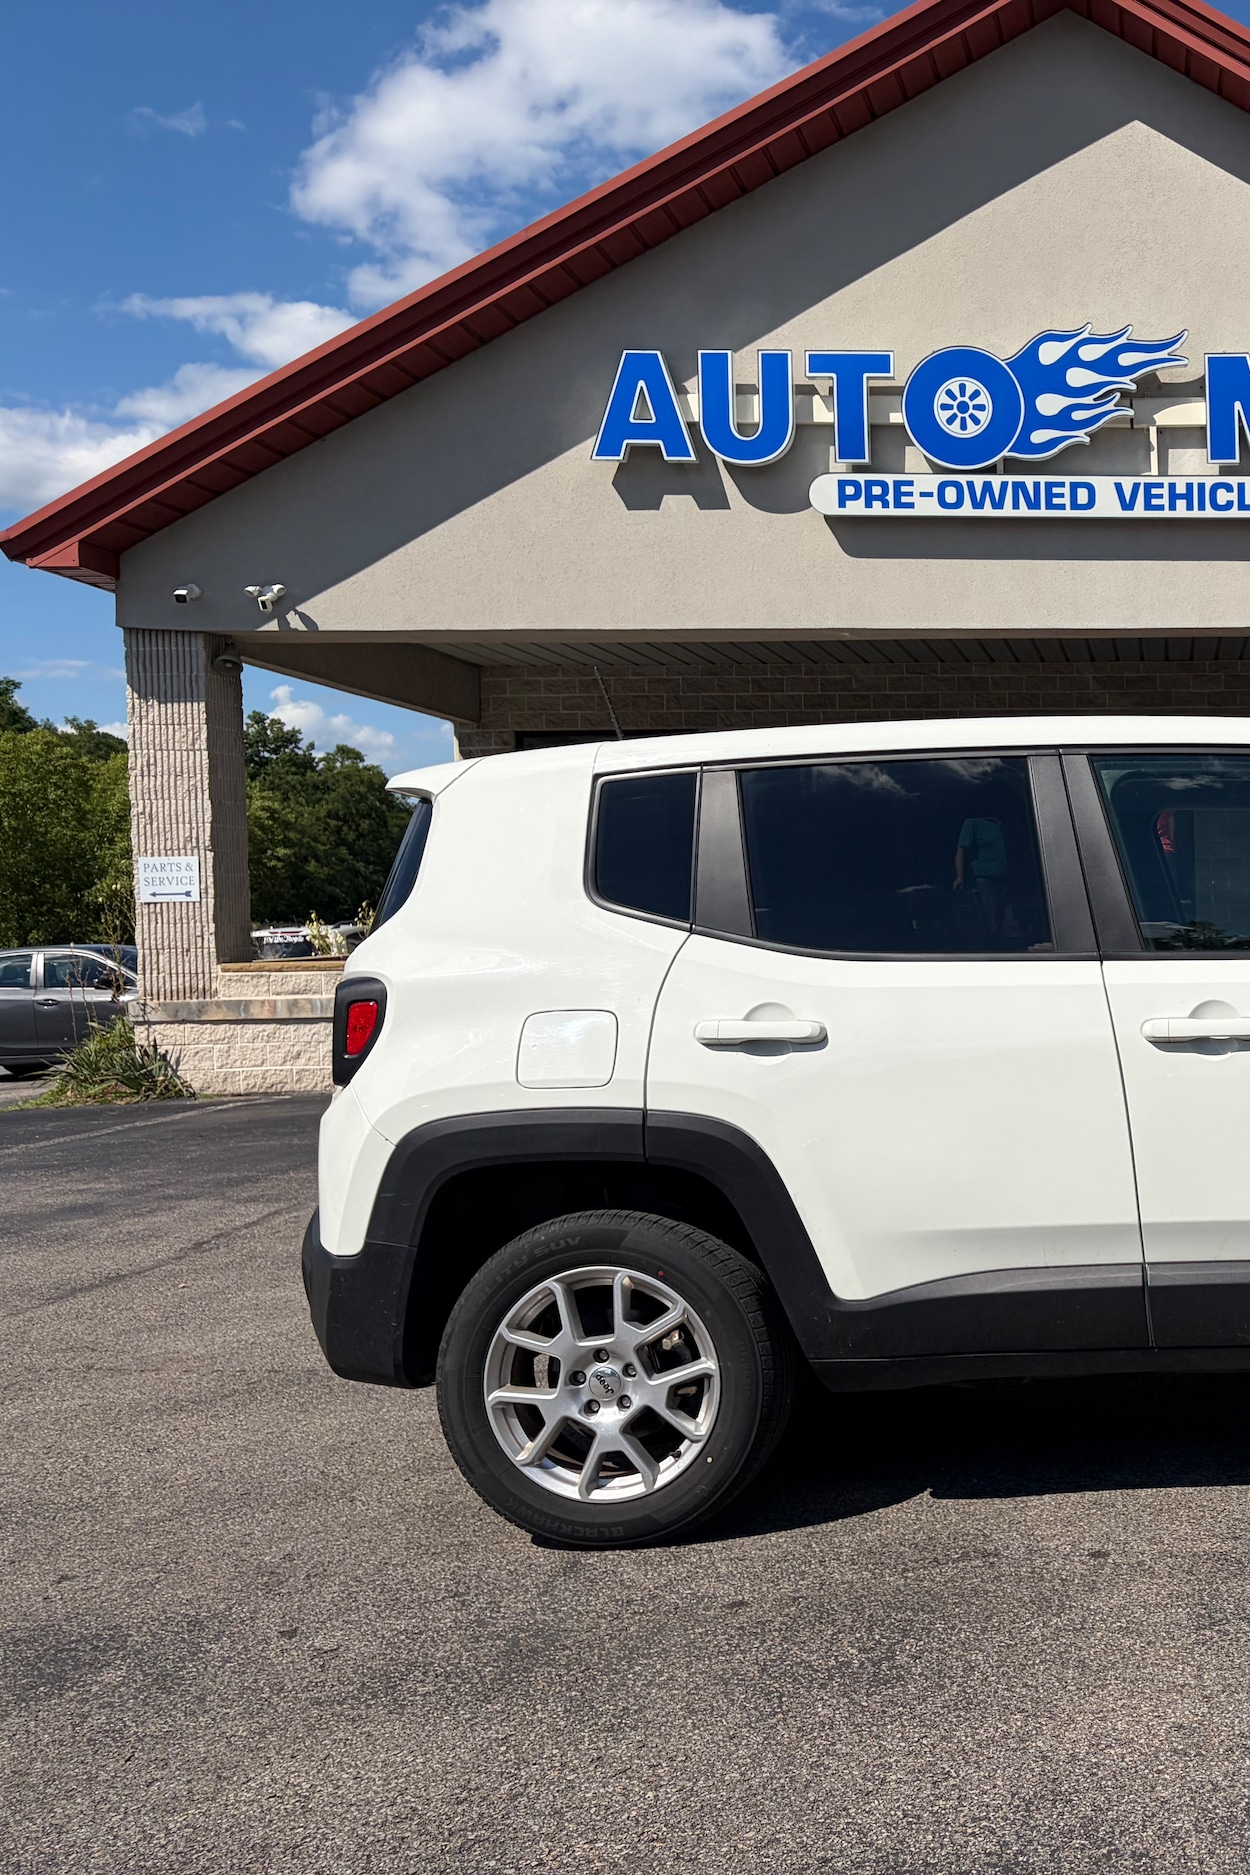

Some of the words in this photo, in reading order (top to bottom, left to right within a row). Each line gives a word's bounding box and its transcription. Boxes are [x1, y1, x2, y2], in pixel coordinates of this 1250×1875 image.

[591, 346, 1028, 470] AUTO
[837, 479, 1096, 511] PRE-OWNED
[143, 862, 182, 873] PARTS
[185, 862, 194, 872] &
[143, 875, 195, 887] SERVICE
[534, 1235, 582, 1258] SUV
[595, 1374, 614, 1394] Jeep
[502, 1496, 625, 1538] BLACKHAWK
